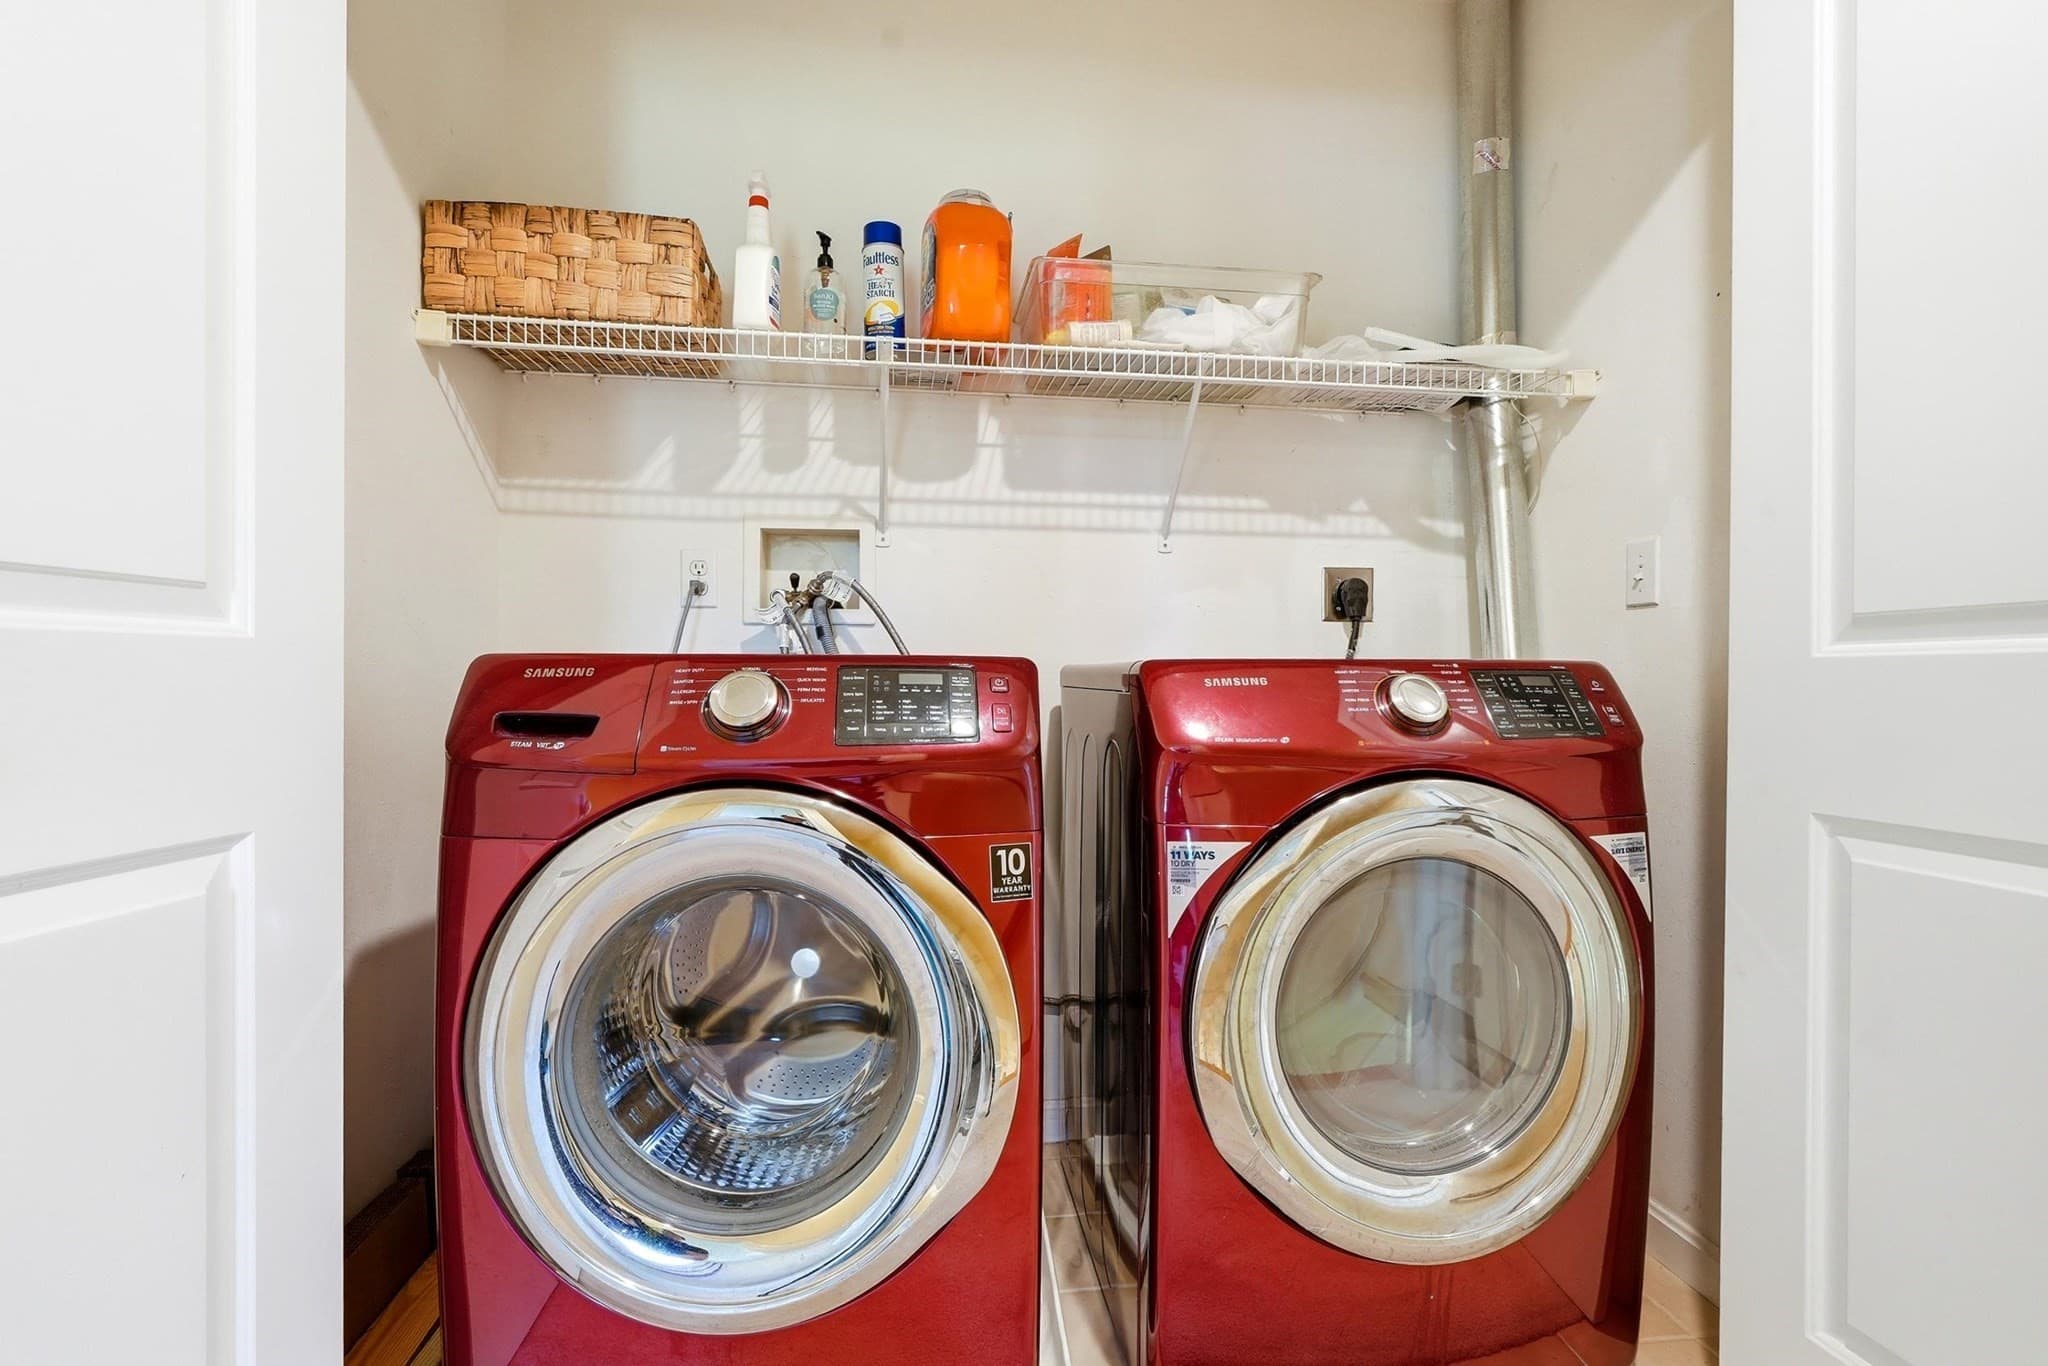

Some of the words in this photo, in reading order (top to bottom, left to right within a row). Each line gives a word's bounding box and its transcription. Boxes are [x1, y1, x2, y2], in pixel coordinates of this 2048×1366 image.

[866, 289, 895, 299] STARCH
[523, 667, 596, 678] SAMSUNG
[1204, 677, 1269, 688] SAMSUNG
[1170, 851, 1181, 860] 11
[1184, 851, 1216, 860] WAYS
[995, 847, 1026, 876] 10
[1180, 860, 1196, 868] DRY
[1001, 876, 1023, 886] YEAR
[993, 885, 1031, 894] WARRANTY
